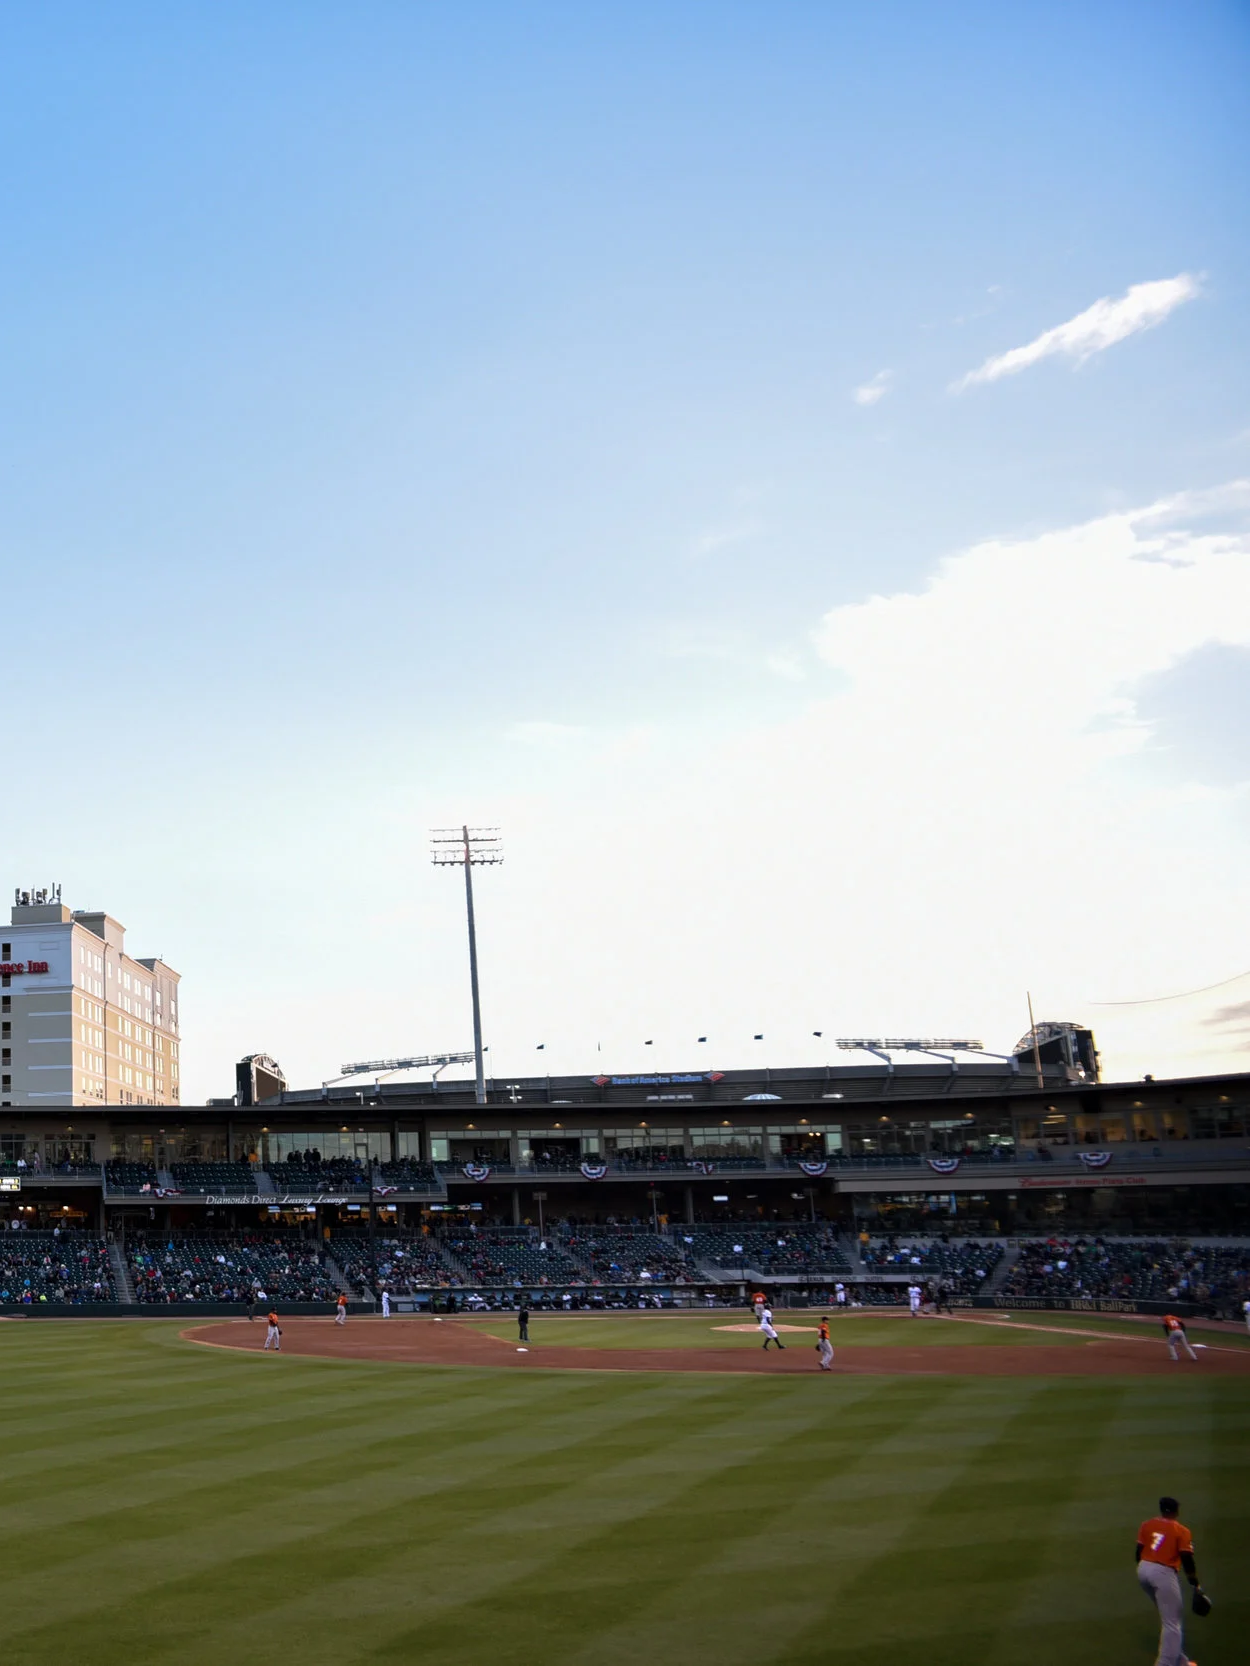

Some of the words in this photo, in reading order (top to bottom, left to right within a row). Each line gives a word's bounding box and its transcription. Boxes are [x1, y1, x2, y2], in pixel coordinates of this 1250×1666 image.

[27, 960, 49, 974] Inn
[611, 1076, 630, 1085] Bank
[631, 1076, 639, 1084] of
[639, 1075, 670, 1084] America
[671, 1074, 703, 1083] Stadium
[205, 1195, 250, 1205] Diamonds
[251, 1195, 277, 1205] Direct
[279, 1195, 313, 1207] Luxury
[313, 1194, 349, 1206] Lounge
[994, 1298, 1047, 1308] Welcome
[1053, 1300, 1066, 1308] to
[1100, 1300, 1138, 1312] BallPark
[1151, 1531, 1165, 1551] 7
